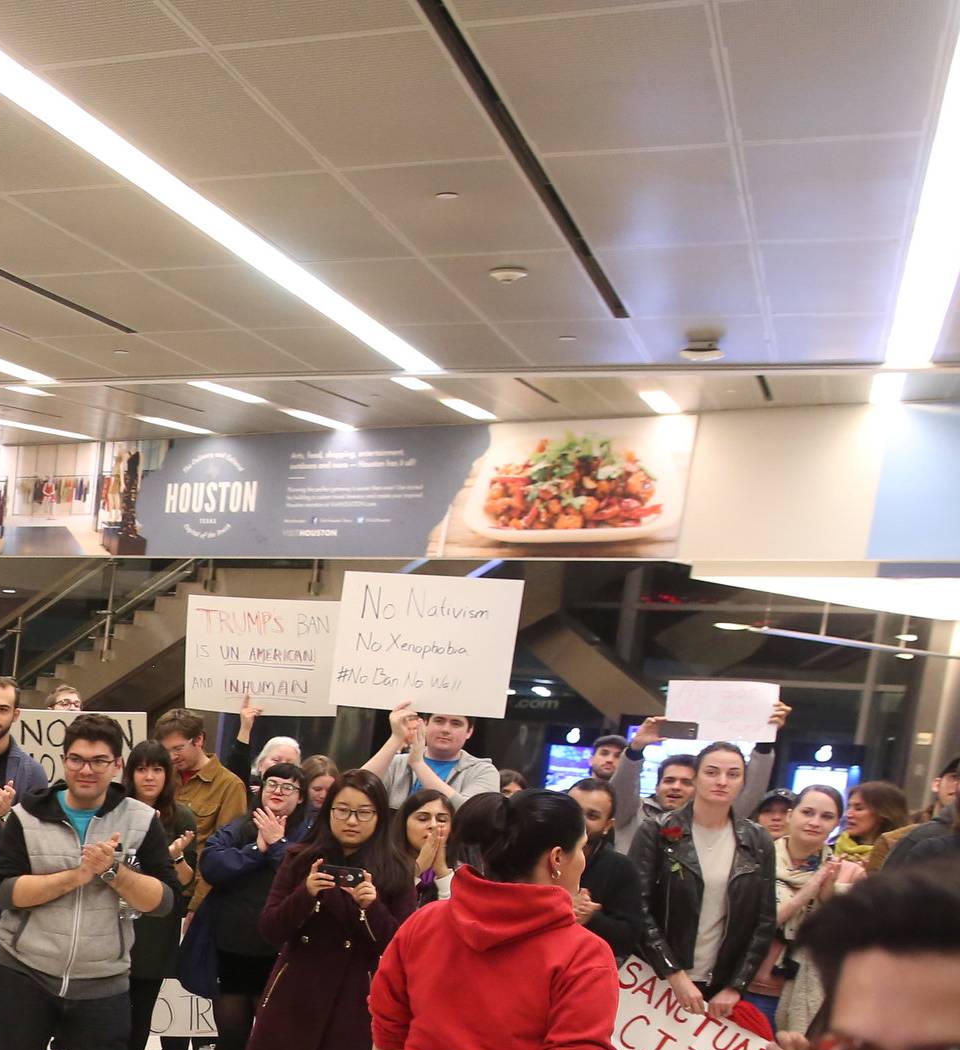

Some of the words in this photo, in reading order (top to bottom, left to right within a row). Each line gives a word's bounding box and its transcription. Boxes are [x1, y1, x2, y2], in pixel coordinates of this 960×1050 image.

[165, 481, 257, 513] HOUSTON
[361, 584, 396, 619] No
[407, 587, 489, 619] Nativism
[297, 613, 330, 637] BAN
[196, 644, 210, 659] IS
[220, 645, 239, 660] UN
[356, 632, 382, 652] No
[386, 632, 467, 659] Xenophobia
[192, 676, 213, 689] AND
[224, 678, 309, 695] INHUMAN
